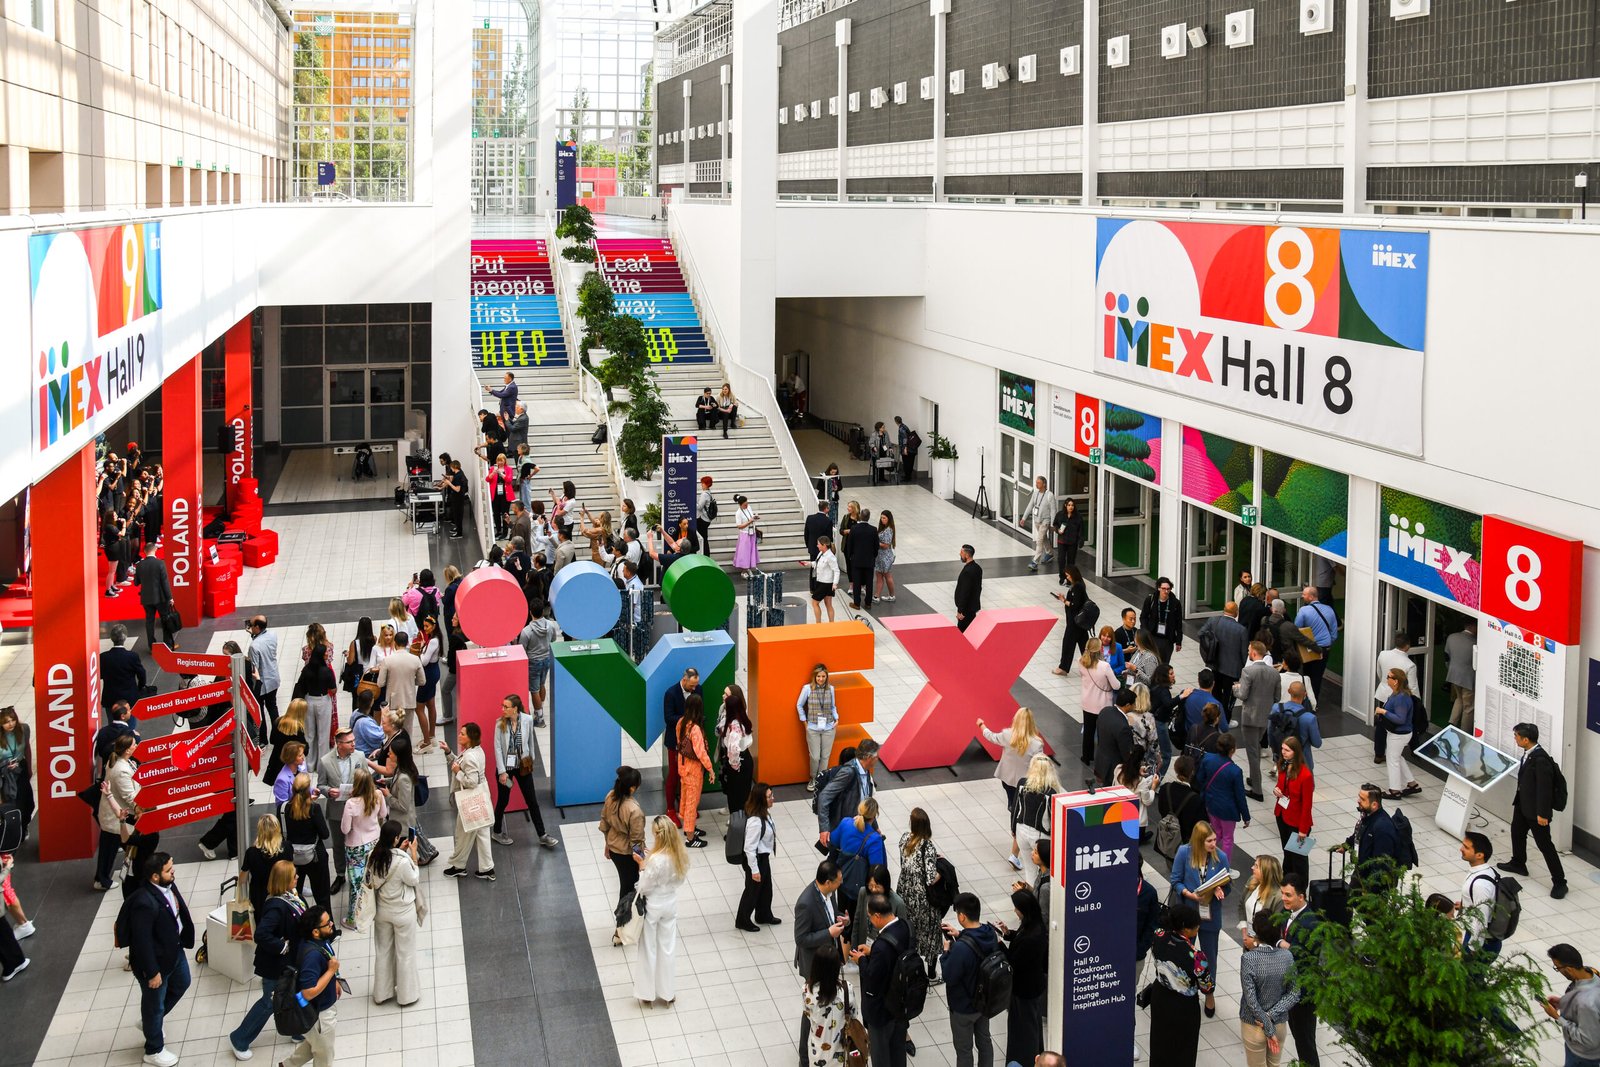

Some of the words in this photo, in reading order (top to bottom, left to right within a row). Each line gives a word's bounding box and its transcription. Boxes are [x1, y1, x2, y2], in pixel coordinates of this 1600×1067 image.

[472, 255, 507, 274] Put
[601, 254, 652, 272] Lead
[122, 224, 138, 325] 9
[606, 274, 642, 294] the
[1264, 226, 1315, 331] 8
[474, 276, 545, 300] people
[474, 303, 526, 324] first.
[612, 300, 663, 320] way.
[482, 330, 548, 366] KEEP
[107, 335, 136, 404] Hall
[136, 333, 145, 382] 9
[1222, 336, 1305, 404] Hall
[1322, 356, 1354, 414] 8
[1080, 407, 1095, 446] 8
[232, 418, 245, 484] POLAND
[172, 498, 190, 587] POLAND
[1504, 544, 1542, 612] 8
[1534, 634, 1541, 647] 8
[176, 658, 215, 668] Registration
[146, 700, 173, 712] Hosted
[175, 696, 196, 706] Buyer
[198, 690, 225, 700] Lounge
[48, 663, 76, 798] POLAND
[186, 732, 214, 758] Well-being
[214, 718, 232, 736] Lounge
[148, 744, 167, 754] IMEX
[198, 756, 217, 765] Drop
[168, 780, 211, 795] Cloakroom
[168, 809, 188, 820] Food
[190, 804, 212, 814] Court
[1075, 904, 1088, 913] Hall
[1090, 902, 1102, 911] 8.0
[1073, 964, 1112, 976] Cloakroom
[1074, 957, 1087, 966] Hall
[1088, 955, 1100, 964] 9.0
[1073, 975, 1091, 984] Food
[1092, 971, 1117, 982] Market
[1073, 983, 1099, 993] Hosted
[1100, 980, 1120, 989] Buyer
[1072, 998, 1110, 1010] Inspiration
[1111, 994, 1126, 1003] Hub
[1073, 991, 1099, 1002] Lounge
